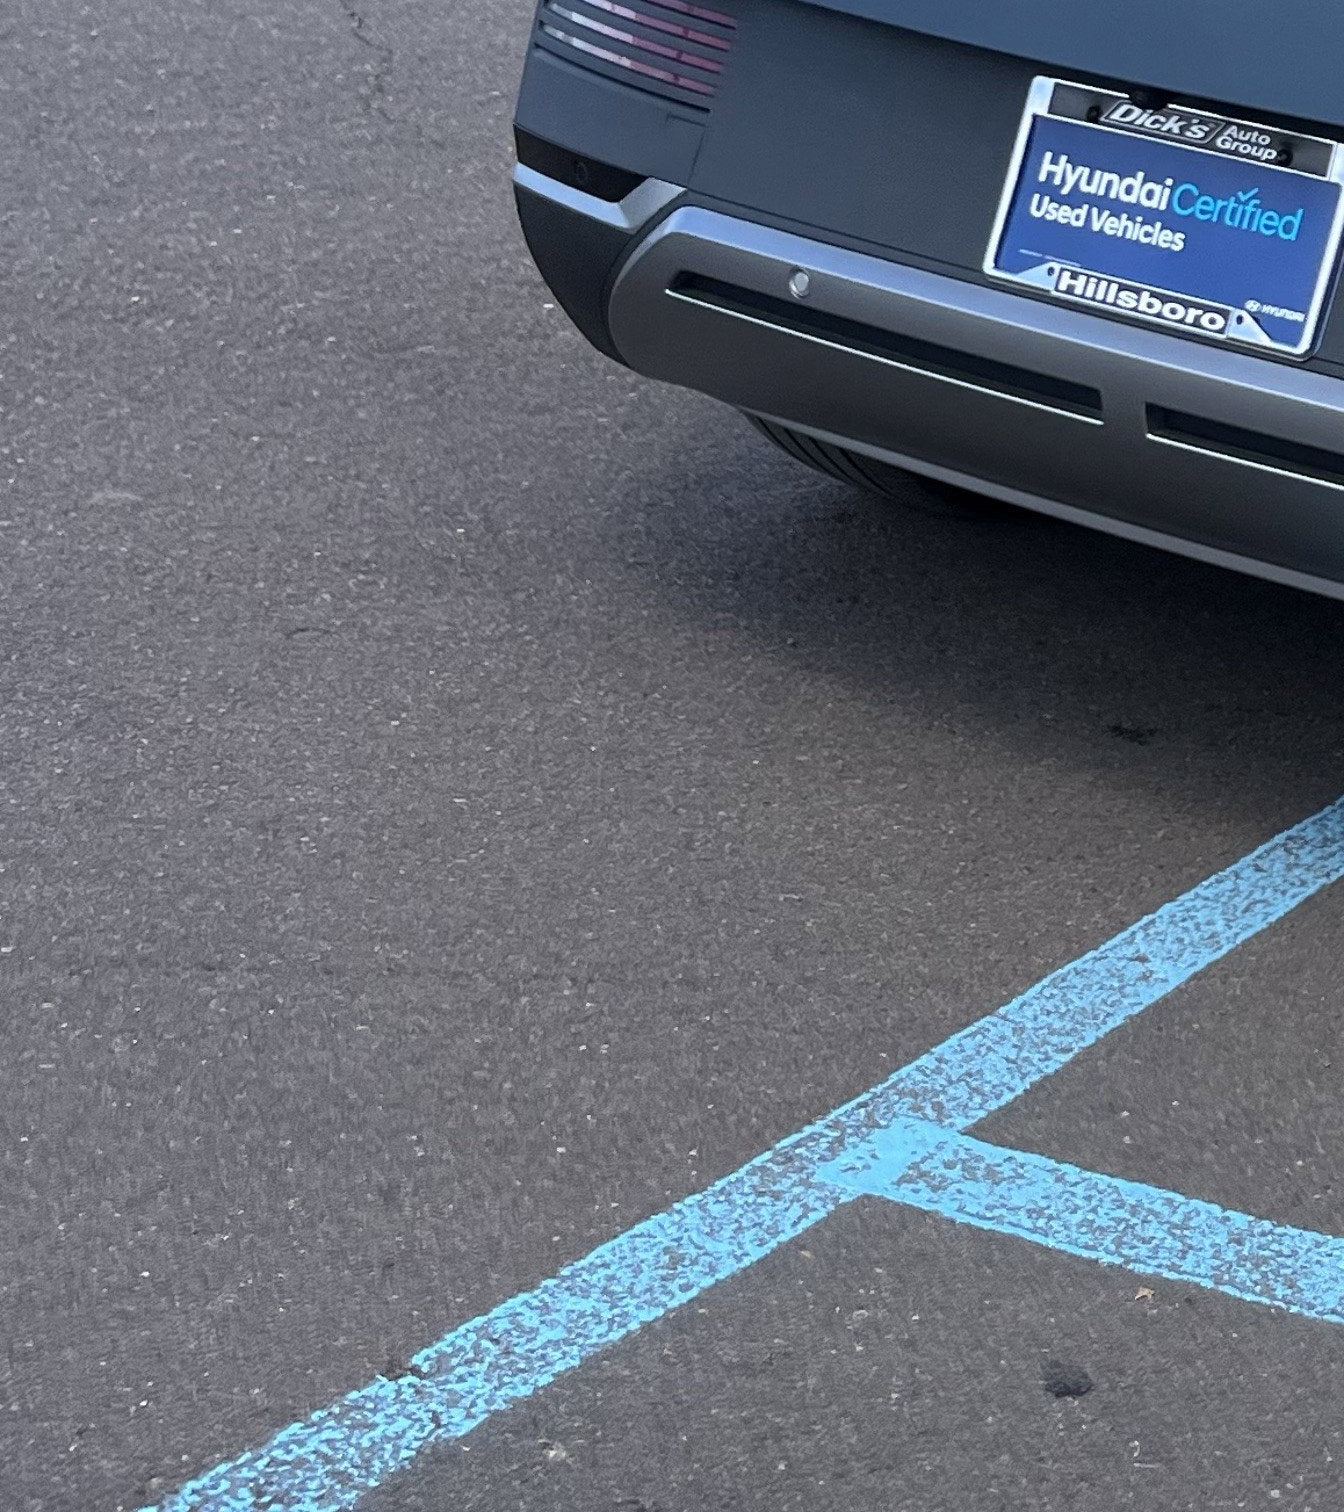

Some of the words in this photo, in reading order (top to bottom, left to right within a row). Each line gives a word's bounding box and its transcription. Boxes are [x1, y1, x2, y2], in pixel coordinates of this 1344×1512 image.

[1109, 103, 1210, 140] Dick's
[1223, 124, 1271, 146] Auto
[1215, 136, 1278, 161] Group
[1030, 193, 1089, 228] Used
[1091, 206, 1186, 252] Vehicles
[1057, 270, 1227, 331] Hillsboro
